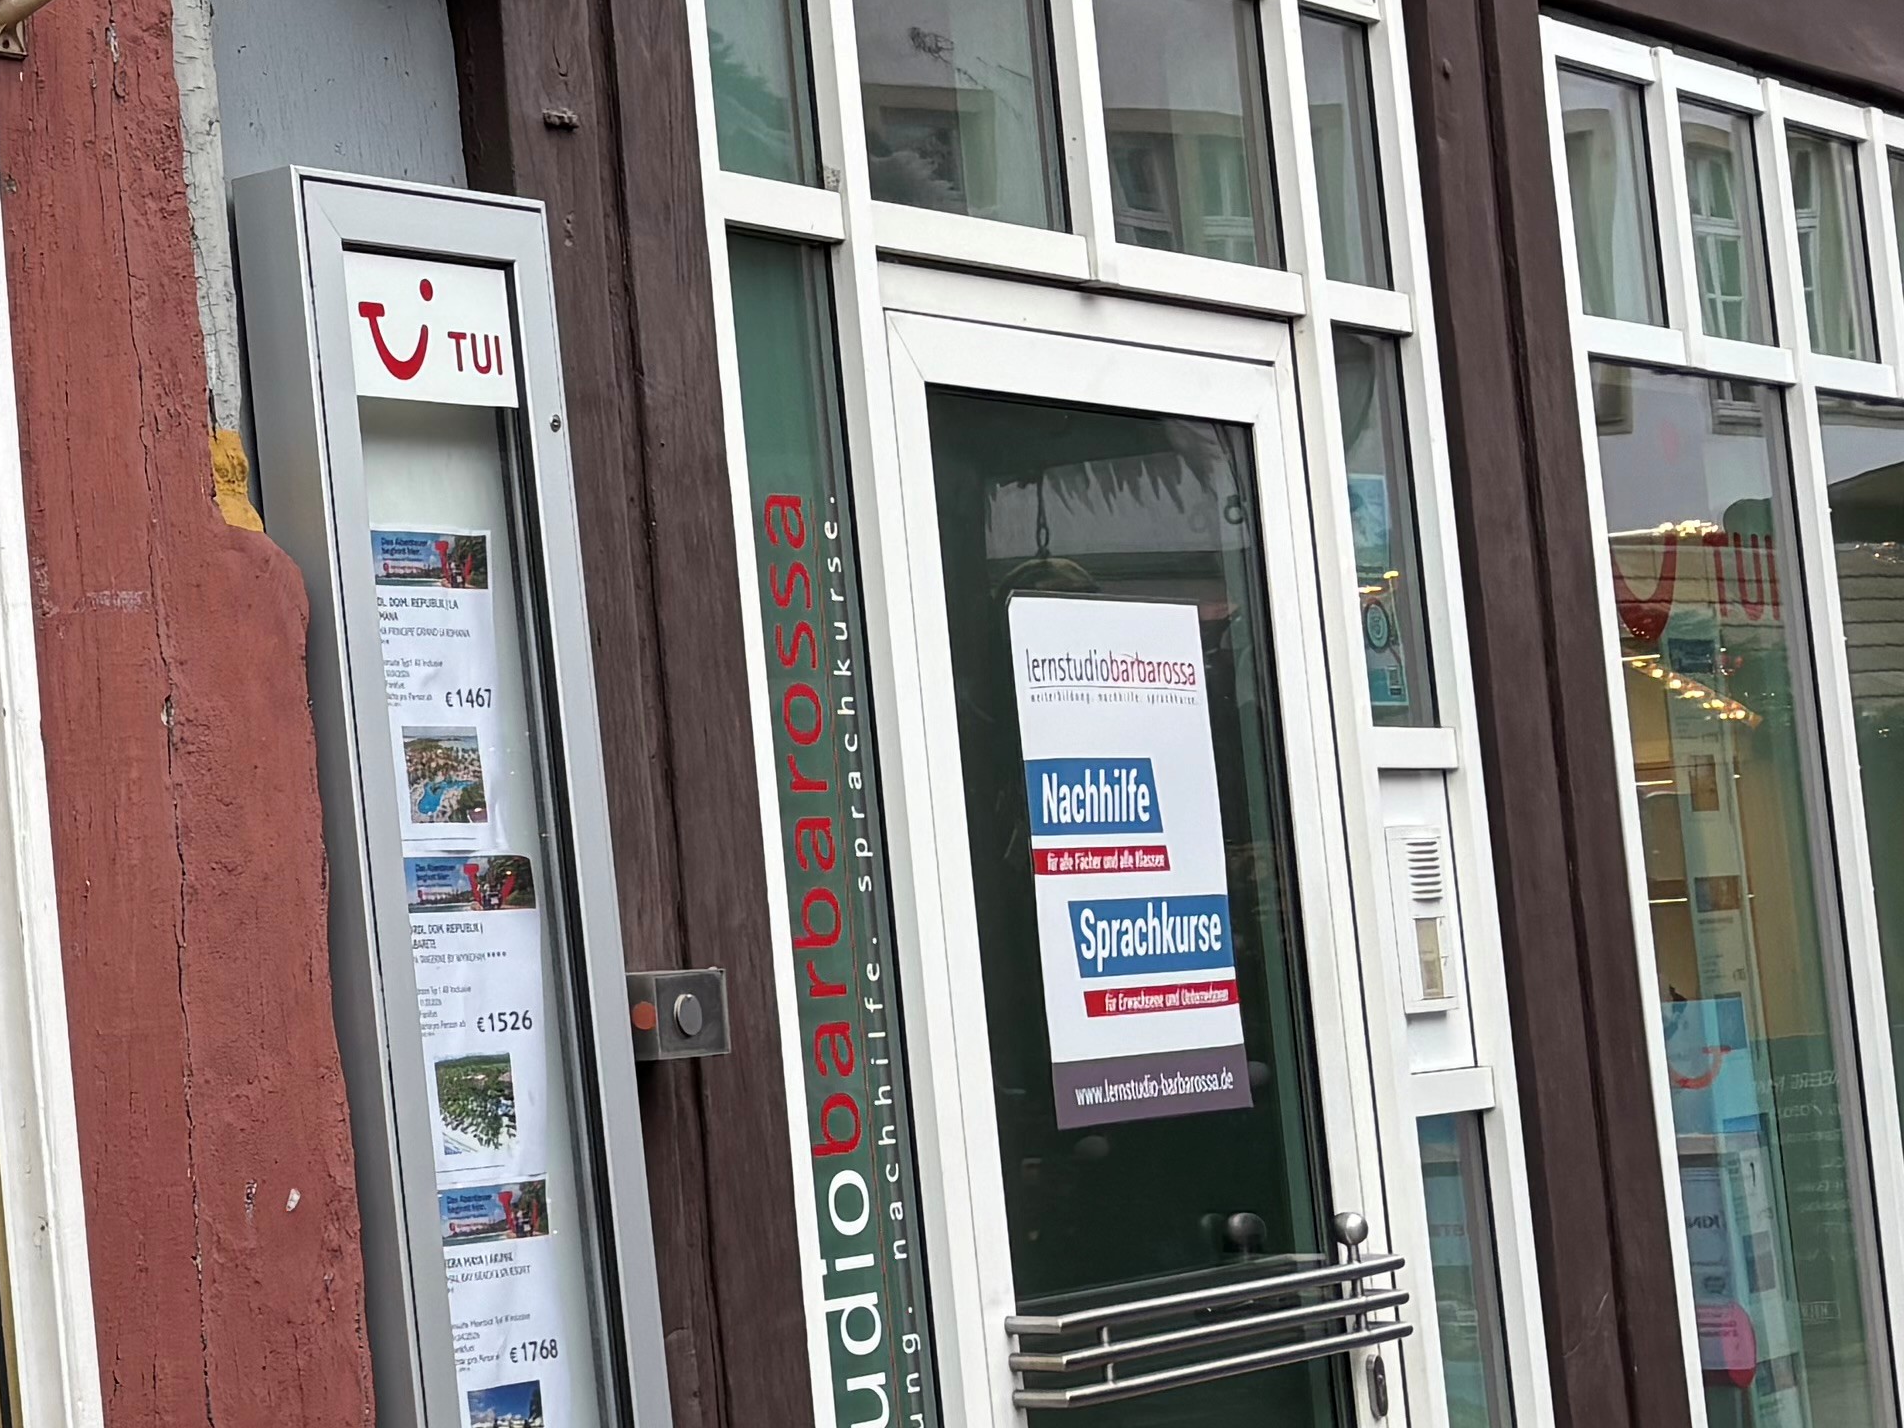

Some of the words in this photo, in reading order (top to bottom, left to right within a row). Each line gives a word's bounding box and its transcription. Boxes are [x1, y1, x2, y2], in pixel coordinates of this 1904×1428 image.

[447, 331, 503, 376] TUI
[1702, 532, 1782, 623] TUI
[1026, 648, 1197, 686] lernstudiobarbarossa
[1041, 767, 1152, 825] Nachhilfe
[1079, 900, 1223, 974] Sprachkurse
